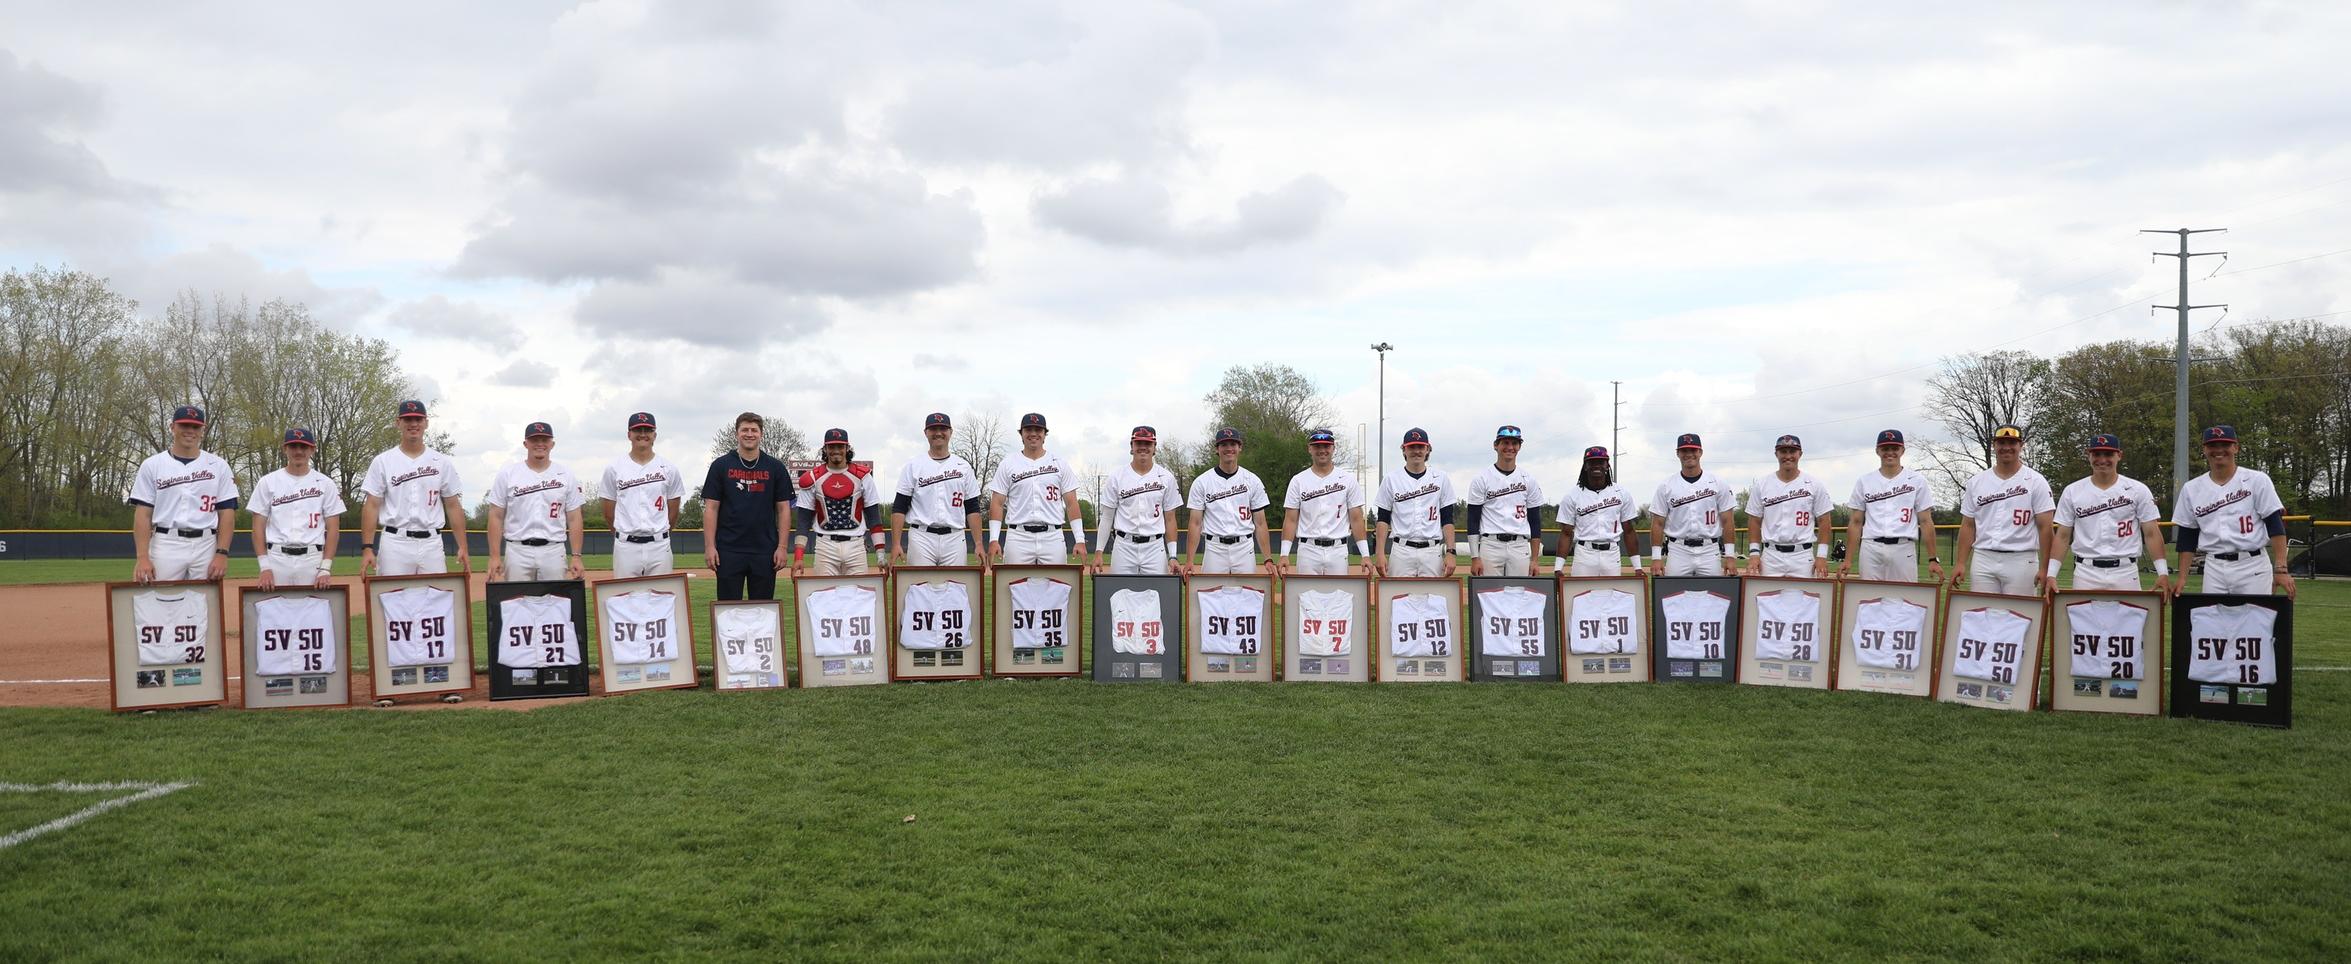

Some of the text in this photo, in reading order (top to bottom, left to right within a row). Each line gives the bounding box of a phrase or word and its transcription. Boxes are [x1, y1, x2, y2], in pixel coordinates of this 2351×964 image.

[1705, 510, 1715, 525] 10
[1796, 511, 1809, 526] 28
[2013, 510, 2031, 526] 50
[2239, 516, 2253, 534] 16
[821, 617, 871, 638] SV SU
[913, 610, 963, 631] SV SU
[1014, 609, 1062, 629] SV SU
[1209, 616, 1256, 635] SV SU
[1303, 620, 1347, 635] SV SU
[1491, 617, 1538, 637] SV SU
[142, 625, 197, 643] SV SU
[390, 616, 445, 641] SV SU
[510, 624, 564, 646] SV SU
[615, 618, 666, 642] SV SU
[1117, 622, 1160, 637] SV SU
[1398, 619, 1446, 642] SV SU
[1580, 617, 1628, 639] SV SU
[1671, 622, 1721, 640] SV SU
[1761, 620, 1813, 642] SV SU
[265, 629, 324, 651] SV SU
[728, 637, 773, 655] SV SU
[854, 639, 871, 654] 48
[945, 633, 962, 648] 26
[1044, 631, 1062, 646] 35
[1146, 639, 1156, 655] 3
[1239, 638, 1256, 653] 43
[1332, 637, 1342, 652] 7
[1521, 639, 1538, 654] 55
[1617, 639, 1623, 653] 1
[1860, 630, 1916, 651] SV SU
[2074, 634, 2134, 658] SV SU
[185, 646, 205, 663] 32
[427, 641, 444, 658] 17
[546, 647, 564, 663] 27
[650, 641, 665, 658] 14
[1431, 641, 1446, 655] 12
[1704, 644, 1719, 658] 10
[1792, 645, 1811, 660] 28
[1960, 638, 2017, 664] SV SU
[2198, 638, 2261, 660] SV SU
[304, 653, 322, 671] 15
[760, 655, 771, 670] 2
[1895, 654, 1912, 670] 31
[2111, 662, 2133, 679] 20
[1992, 666, 2012, 683] 50
[2240, 665, 2259, 683] 16
